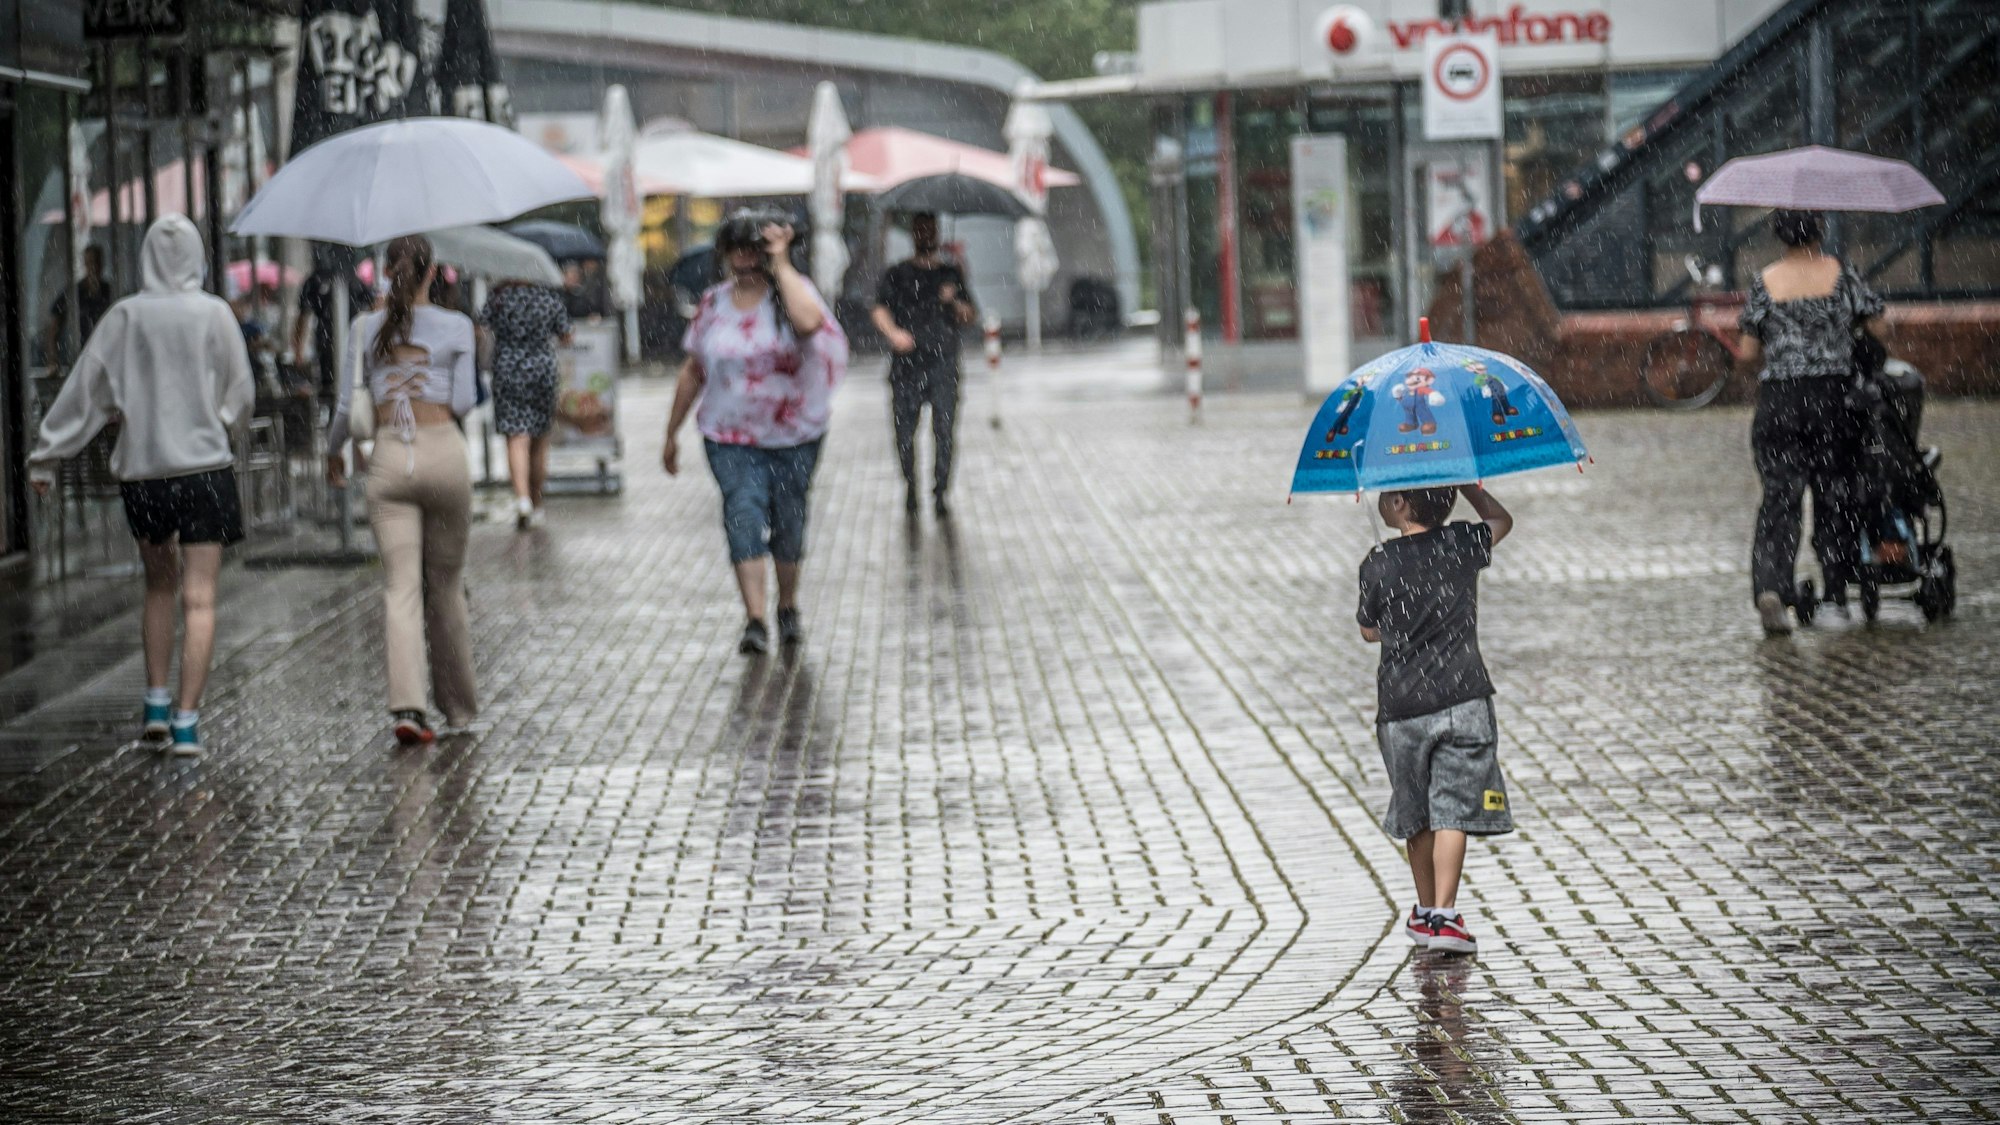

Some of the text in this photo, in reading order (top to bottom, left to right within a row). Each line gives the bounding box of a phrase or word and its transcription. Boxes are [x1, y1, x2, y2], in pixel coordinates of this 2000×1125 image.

[1387, 4, 1611, 48] vafone
[1384, 440, 1450, 456] SUPER MARIO
